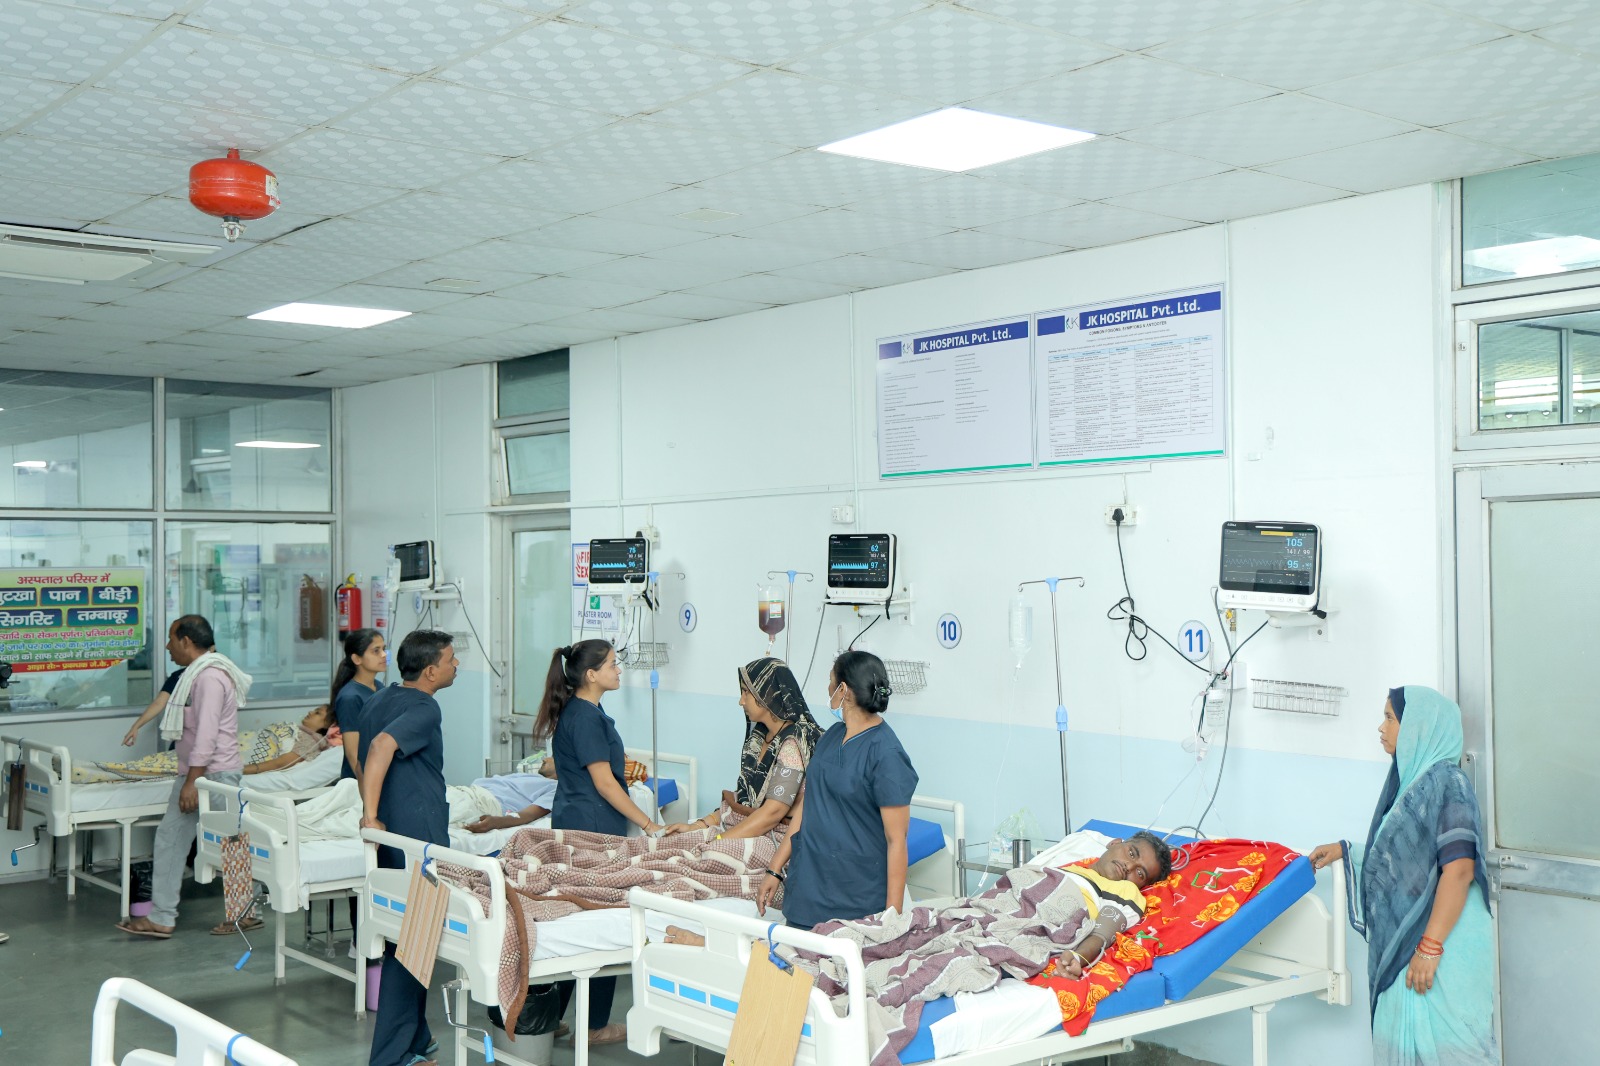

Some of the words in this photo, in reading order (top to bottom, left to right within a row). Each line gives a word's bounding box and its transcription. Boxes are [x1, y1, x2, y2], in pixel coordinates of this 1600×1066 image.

[1086, 314, 1099, 327] JK
[1099, 307, 1149, 325] HOSPITAL
[1151, 304, 1174, 318] Pvt.
[1177, 299, 1201, 313] Ltd.
[918, 341, 930, 352] JK
[929, 335, 970, 351] HOSPITAL
[971, 332, 990, 344] Pvt.
[992, 328, 1012, 341] Ltd.
[870, 544, 879, 552] 62
[1285, 538, 1303, 547] 105
[580, 551, 590, 563] FIR
[870, 561, 879, 569] 97
[1287, 559, 1299, 569] 95
[580, 566, 589, 578] EX
[17, 575, 63, 585] अस्पताल
[66, 572, 98, 584] परिसर
[100, 572, 111, 583] में
[48, 590, 81, 602] पान
[76, 609, 130, 624] तम्बाकू
[597, 611, 612, 619] ROOM
[684, 609, 691, 626] 9
[37, 630, 58, 639] सेवन
[127, 628, 134, 637] है
[940, 620, 957, 641] 10
[1184, 629, 1204, 653] 11
[22, 652, 33, 660] को
[35, 652, 52, 660] साफ
[54, 650, 73, 659] रखने
[75, 649, 83, 658] में
[84, 648, 105, 658] हमारी
